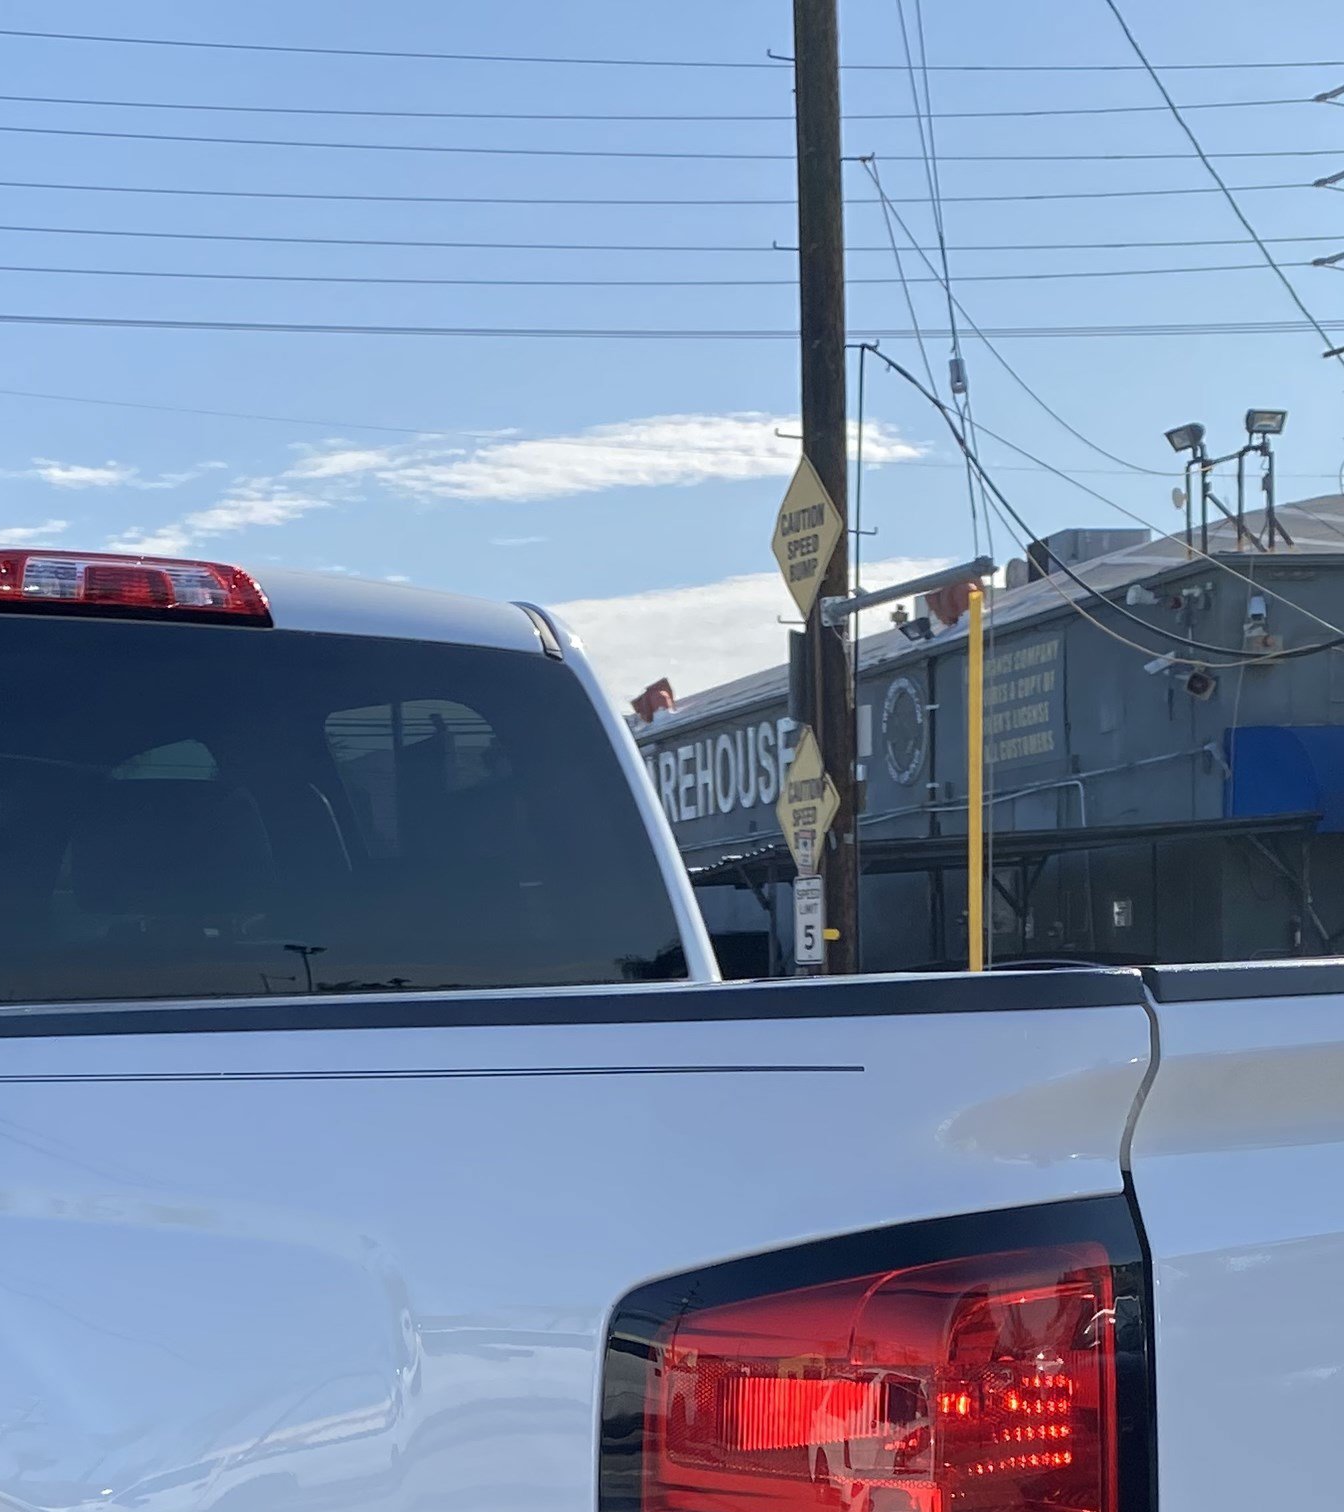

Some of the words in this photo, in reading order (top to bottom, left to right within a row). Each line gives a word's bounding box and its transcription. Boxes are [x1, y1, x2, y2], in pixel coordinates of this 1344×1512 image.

[780, 503, 825, 537] CAUTION
[787, 534, 819, 560] SPEED
[789, 558, 818, 583] BUMP
[804, 925, 815, 950] 5
